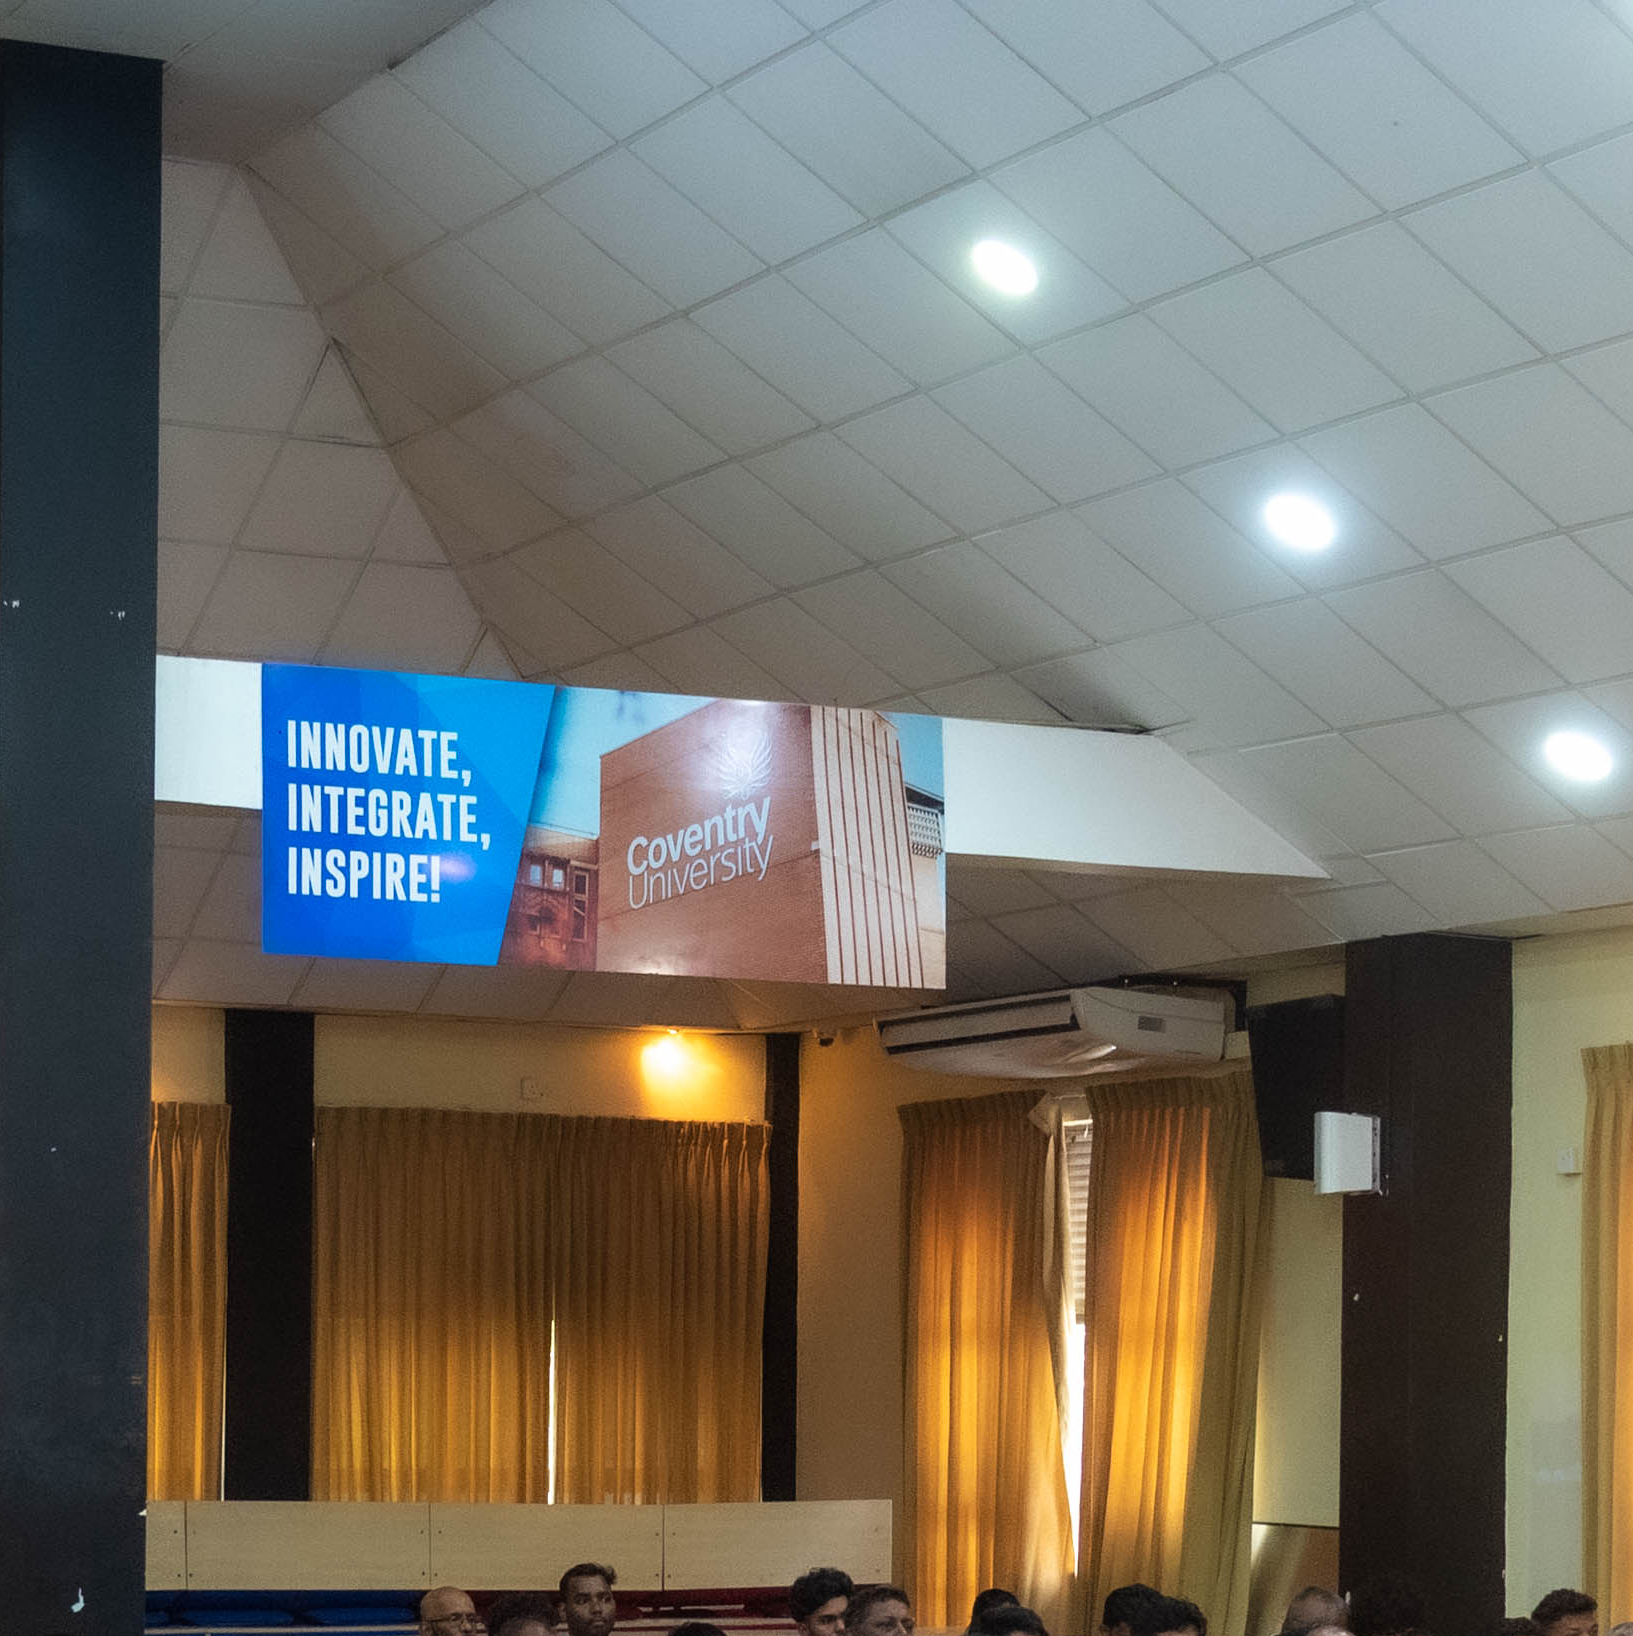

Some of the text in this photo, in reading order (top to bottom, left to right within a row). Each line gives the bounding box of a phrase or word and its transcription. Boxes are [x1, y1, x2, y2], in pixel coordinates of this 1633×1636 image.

[287, 720, 472, 787] INNOVATE,
[288, 783, 491, 850] INTEGRATE,
[627, 796, 771, 856] Coventry
[288, 847, 440, 903] INSPIRE!
[629, 835, 774, 910] University
